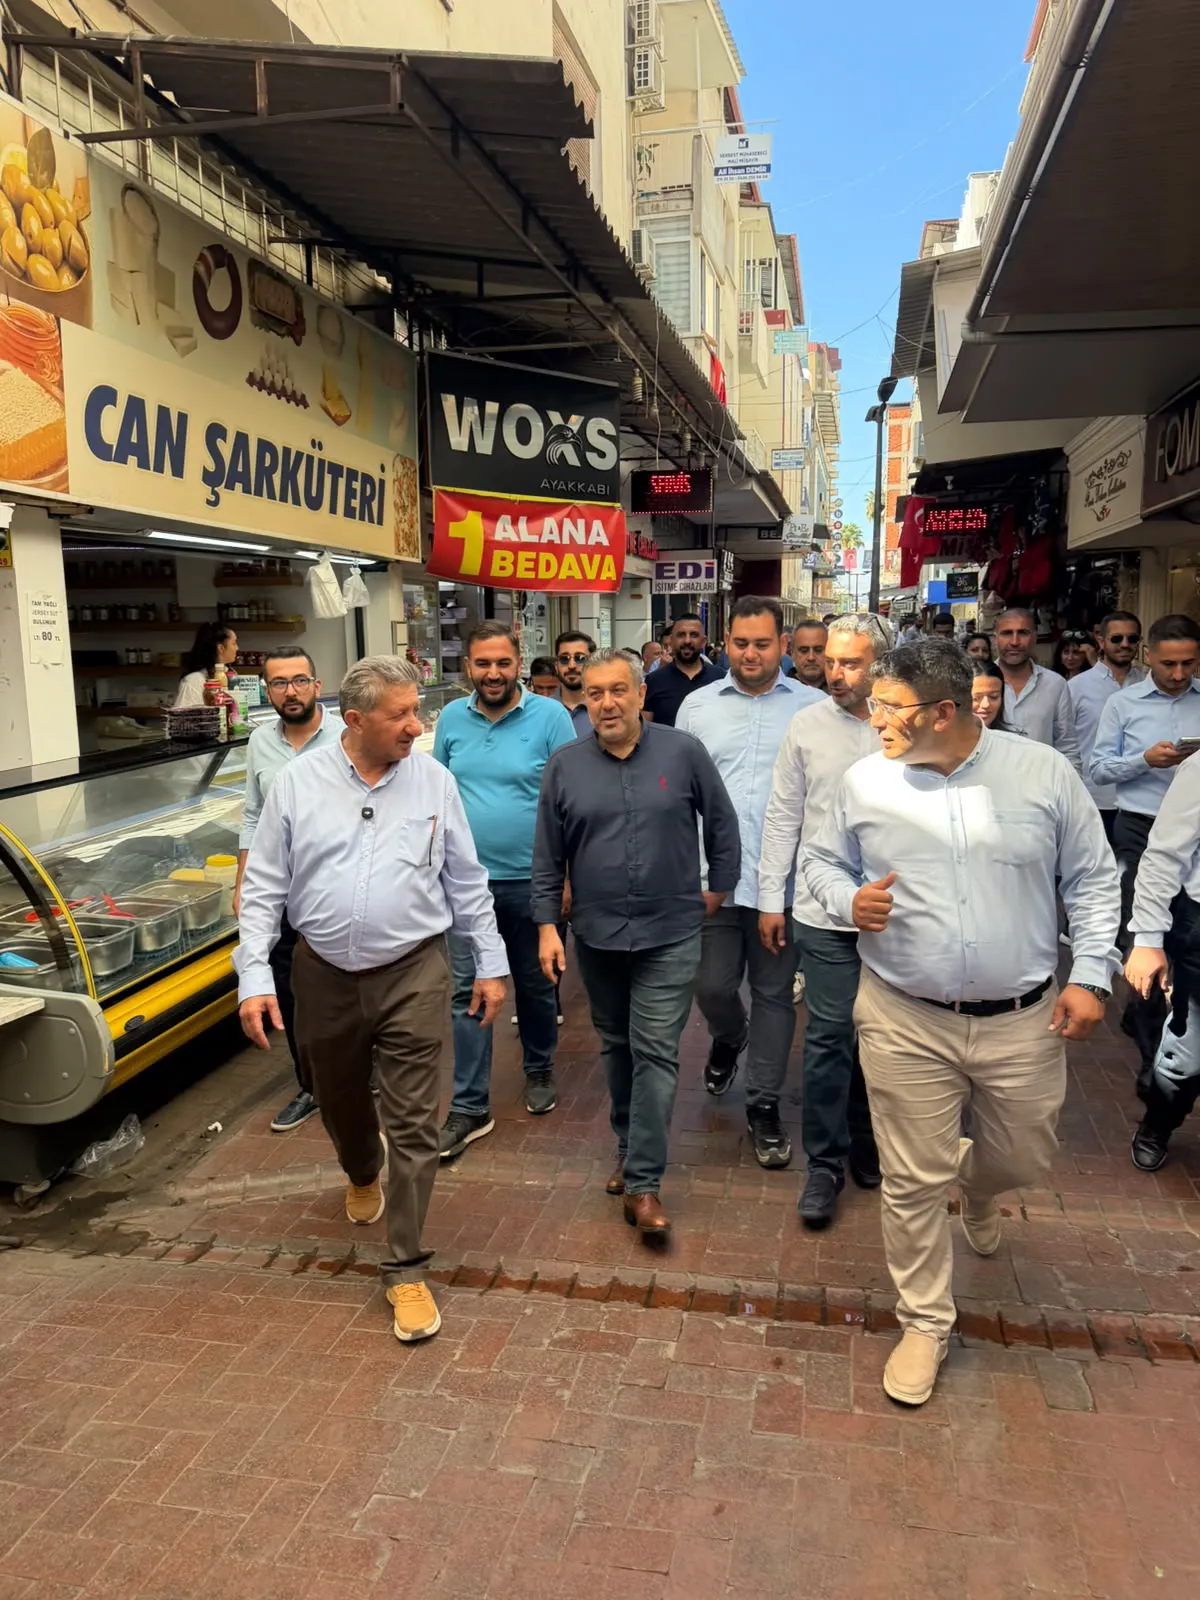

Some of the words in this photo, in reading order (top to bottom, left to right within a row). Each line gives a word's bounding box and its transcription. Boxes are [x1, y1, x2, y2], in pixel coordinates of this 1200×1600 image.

[84, 384, 188, 479] CAN
[202, 421, 386, 527] ŞARKÜTERİ
[440, 393, 618, 471] WOXS
[540, 478, 610, 496] AYAKKABI
[448, 510, 485, 576] 1
[494, 514, 610, 547] ALANA
[489, 550, 617, 581] BEDAVA
[42, 631, 52, 641] 80
